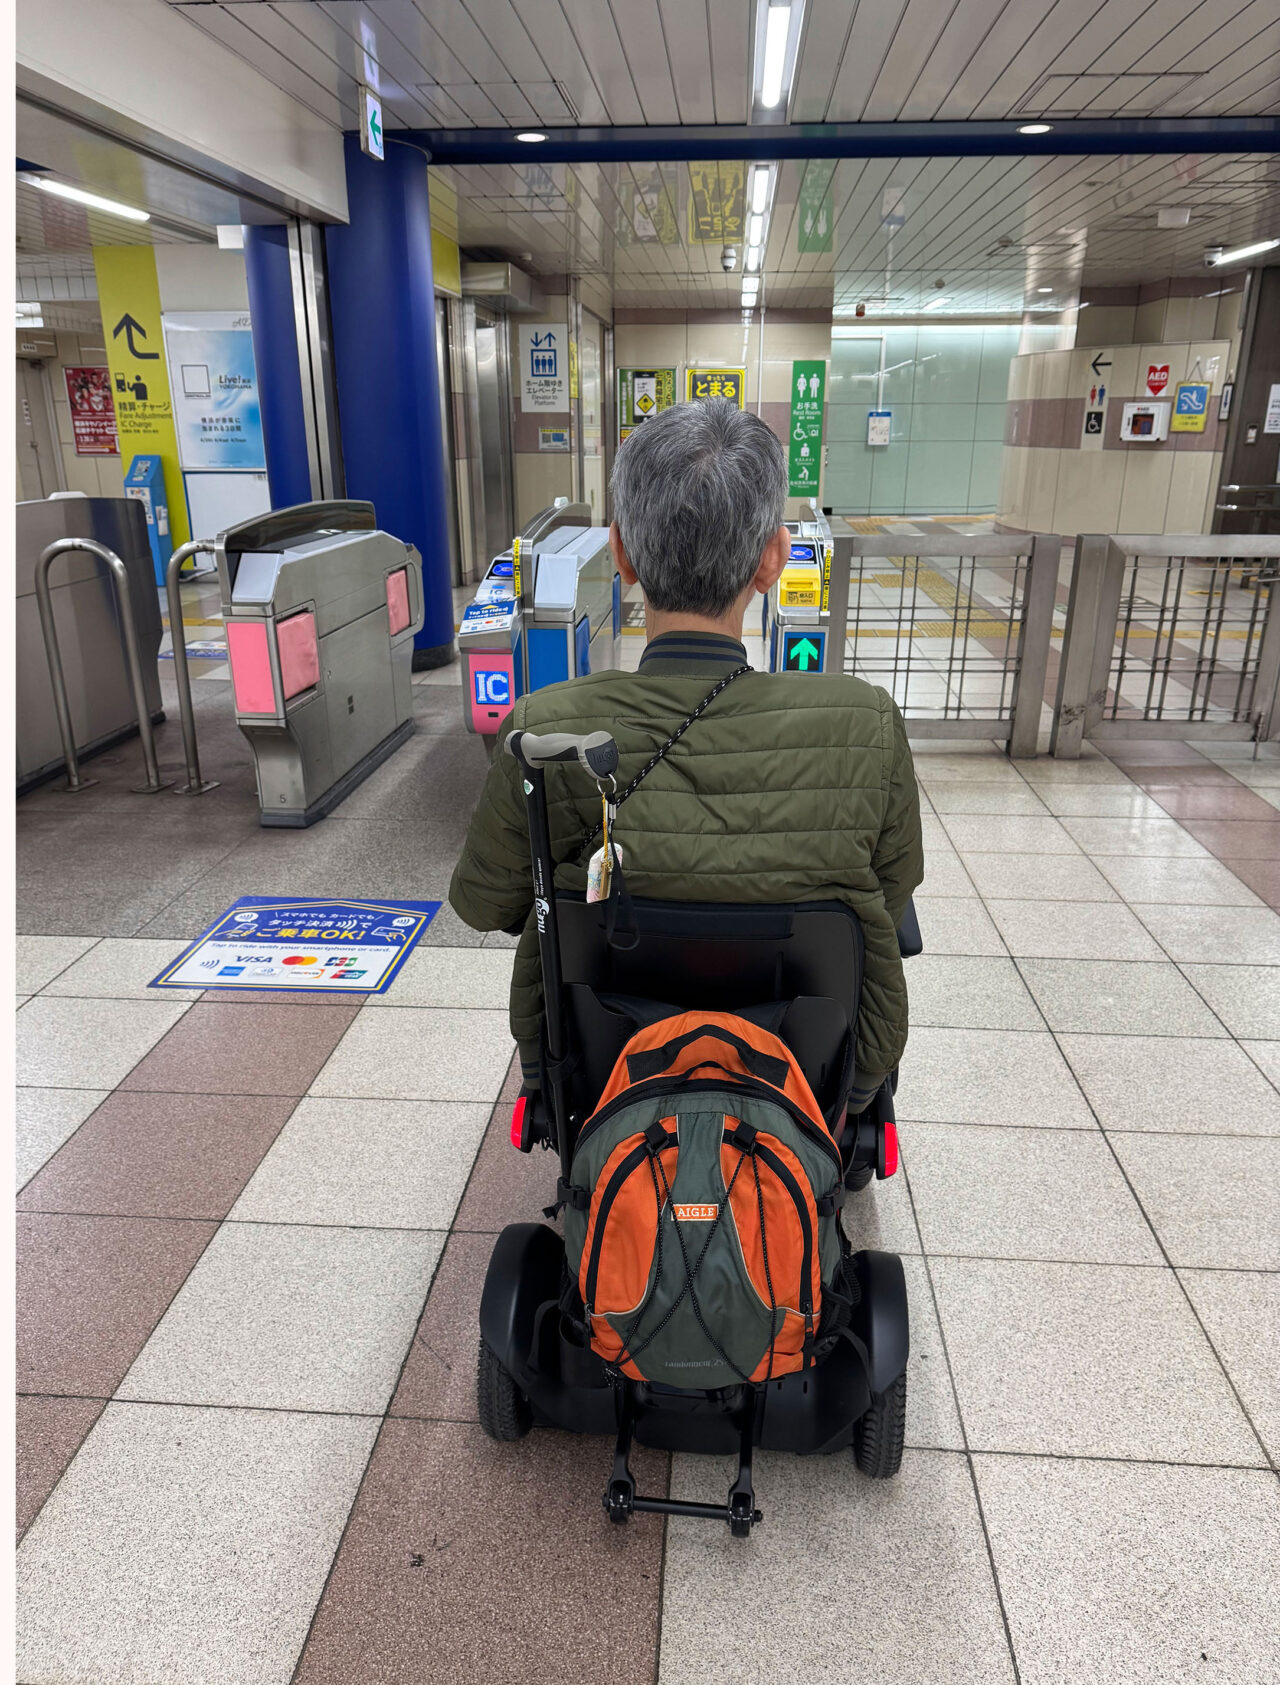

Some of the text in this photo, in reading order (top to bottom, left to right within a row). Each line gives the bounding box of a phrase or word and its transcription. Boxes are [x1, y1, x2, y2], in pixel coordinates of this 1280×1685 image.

[218, 375, 242, 384] Live!
[1148, 372, 1168, 380] AED
[696, 381, 736, 398] とまる
[796, 402, 818, 410] お手洗
[135, 412, 172, 420] Adjustment
[128, 420, 152, 428] Charge
[476, 674, 508, 702] IC
[268, 920, 334, 928] タッチ決済
[257, 928, 366, 940] ご乗車OK!
[324, 957, 358, 967] JCB
[678, 1208, 714, 1217] AIGLE
